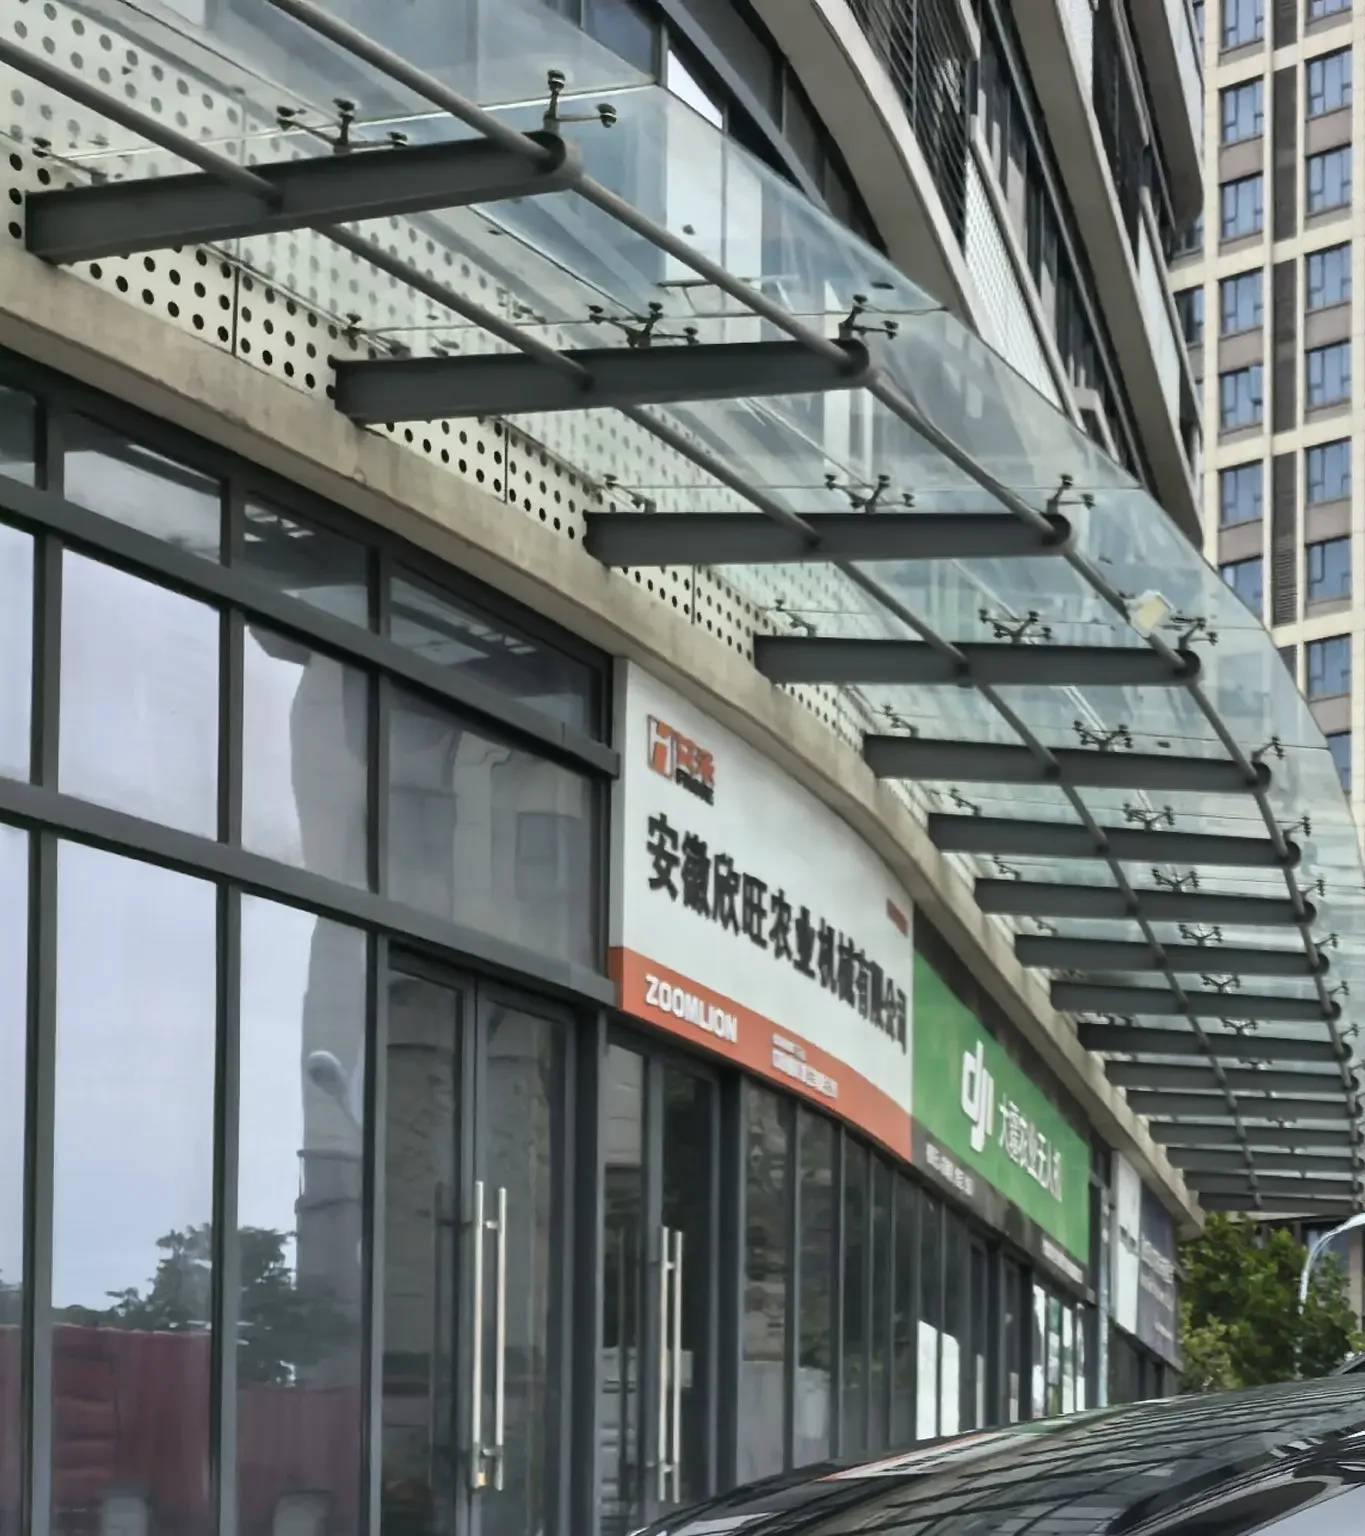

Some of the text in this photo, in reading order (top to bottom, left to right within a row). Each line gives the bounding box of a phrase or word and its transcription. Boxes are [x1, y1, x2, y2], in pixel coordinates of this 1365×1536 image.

[645, 973, 738, 1043] ZOOMLION
[646, 812, 908, 1055] 安徽欣旺农业机械有限公司
